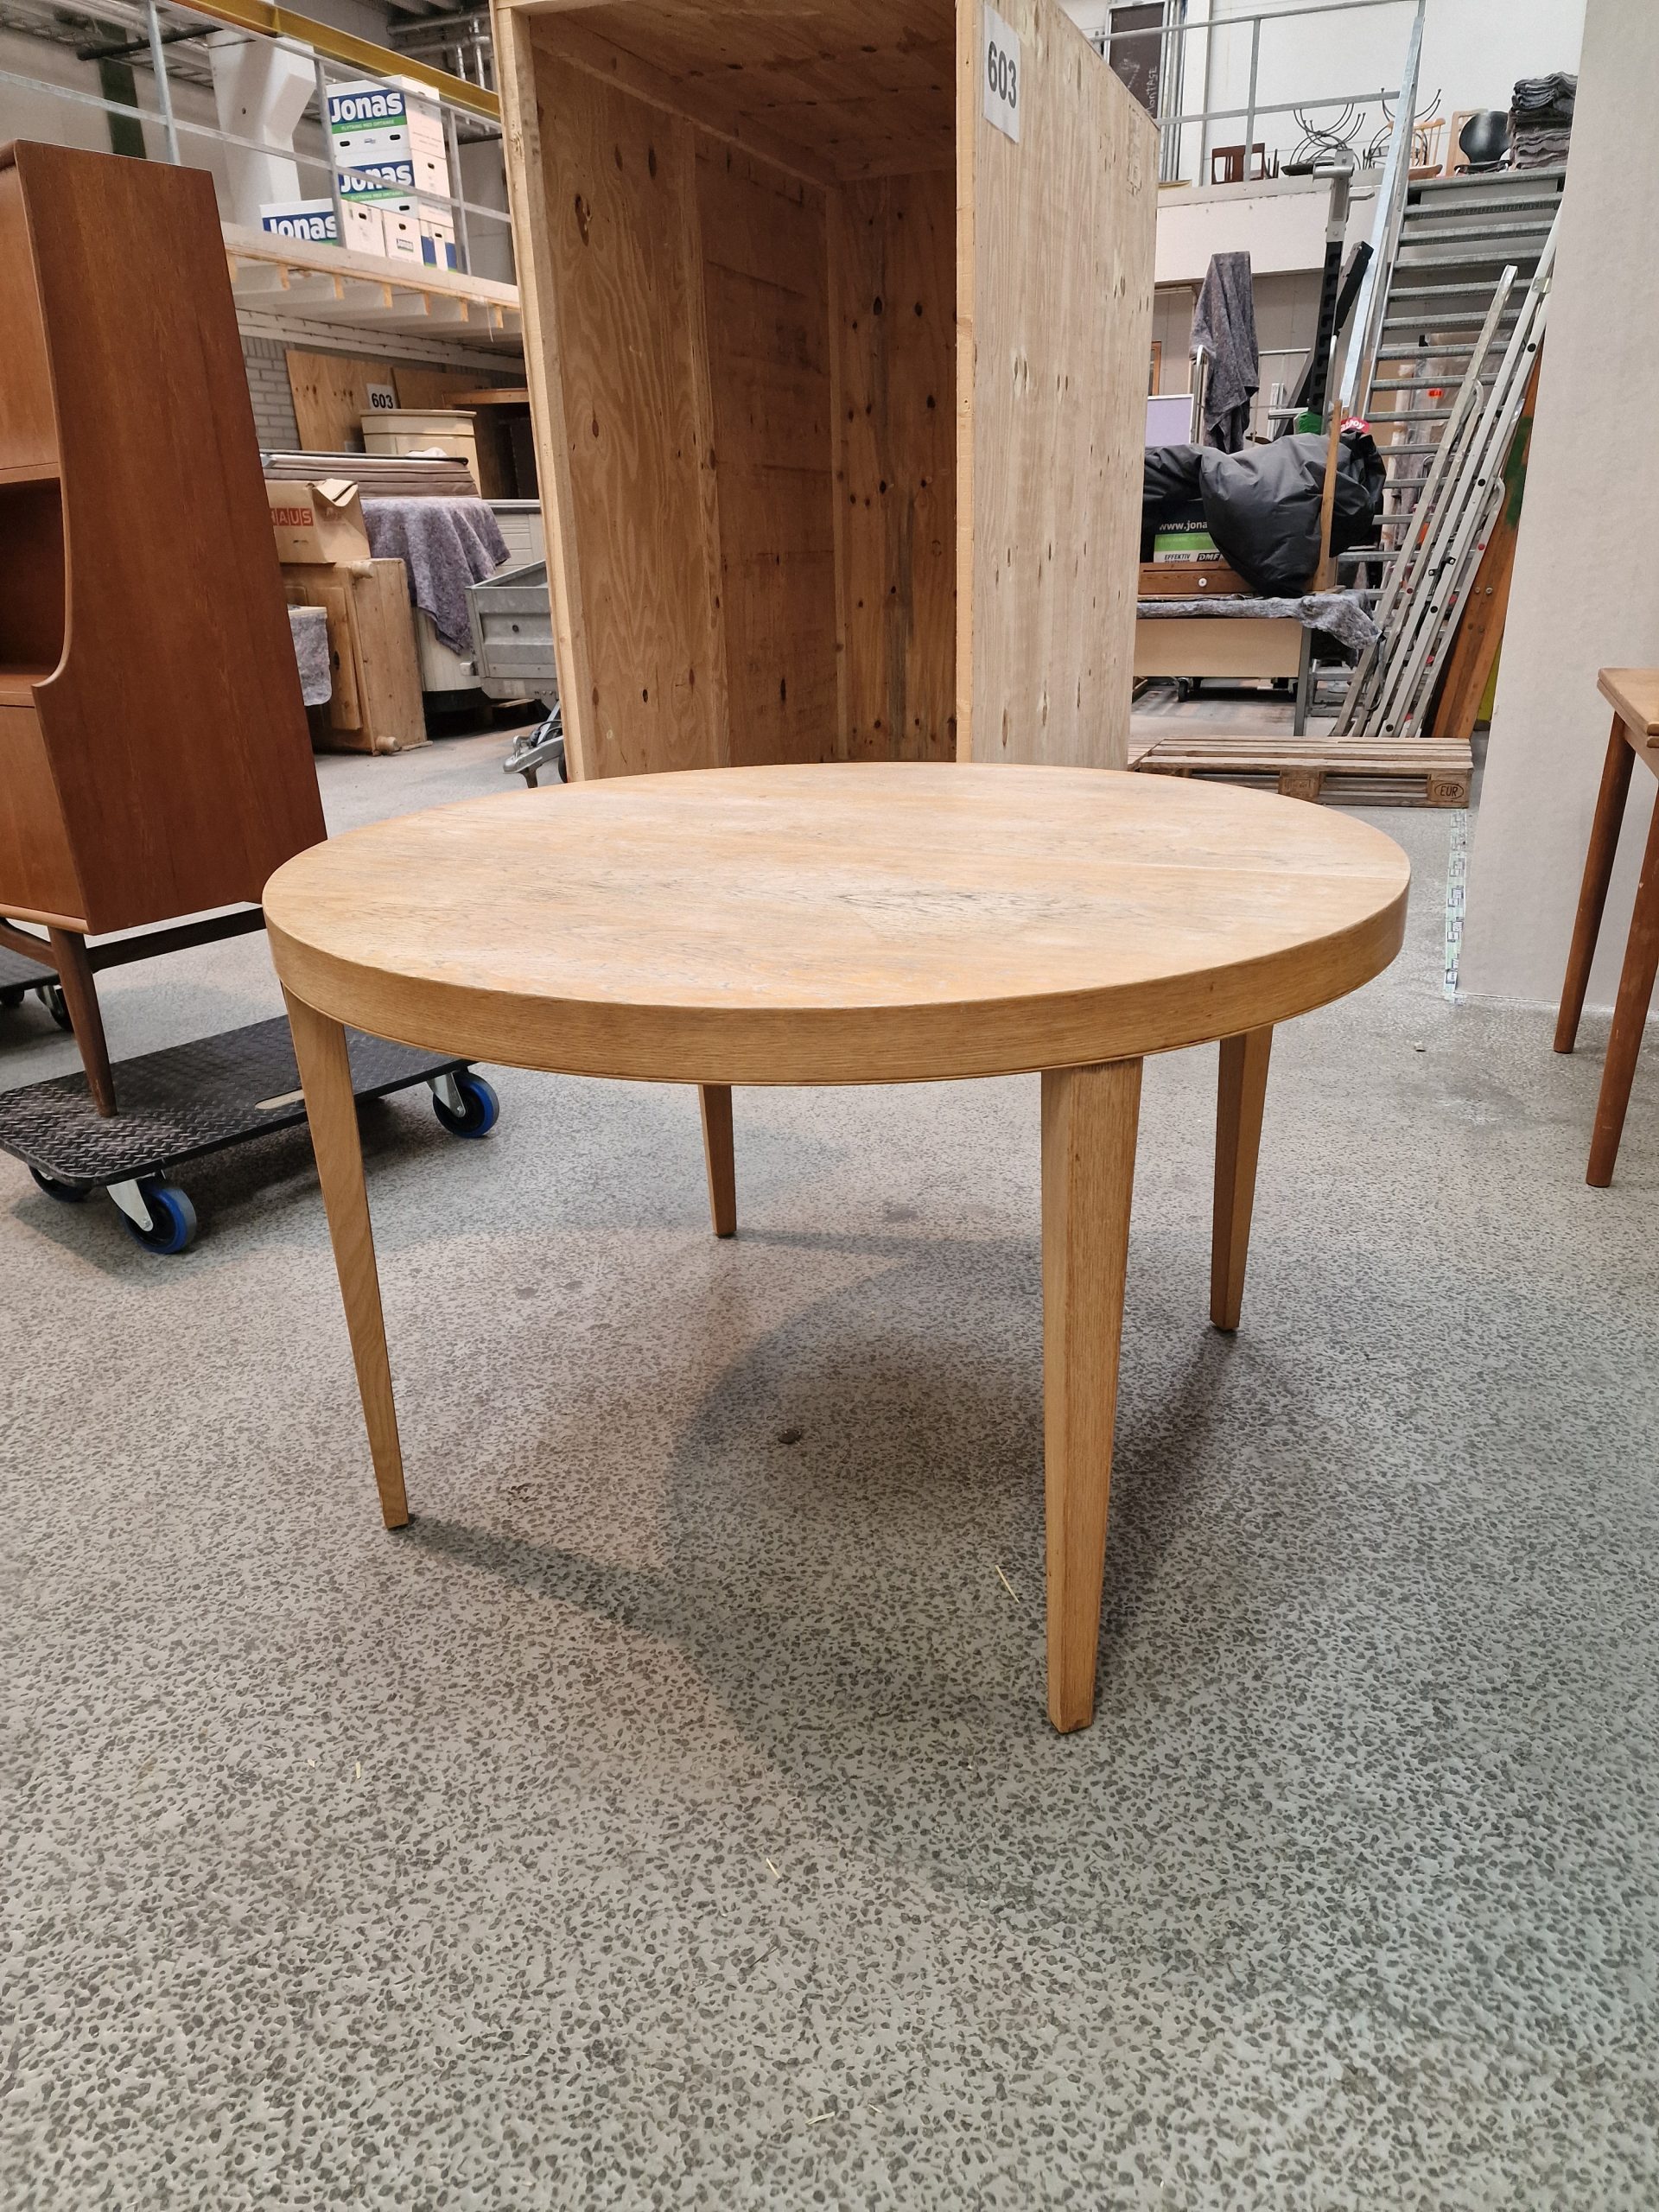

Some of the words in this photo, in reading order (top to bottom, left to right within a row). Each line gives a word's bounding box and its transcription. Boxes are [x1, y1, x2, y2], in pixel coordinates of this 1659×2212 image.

[988, 41, 1017, 109] 603
[331, 92, 404, 123] Jonas
[372, 392, 393, 409] 603
[1440, 785, 1459, 797] EUR
